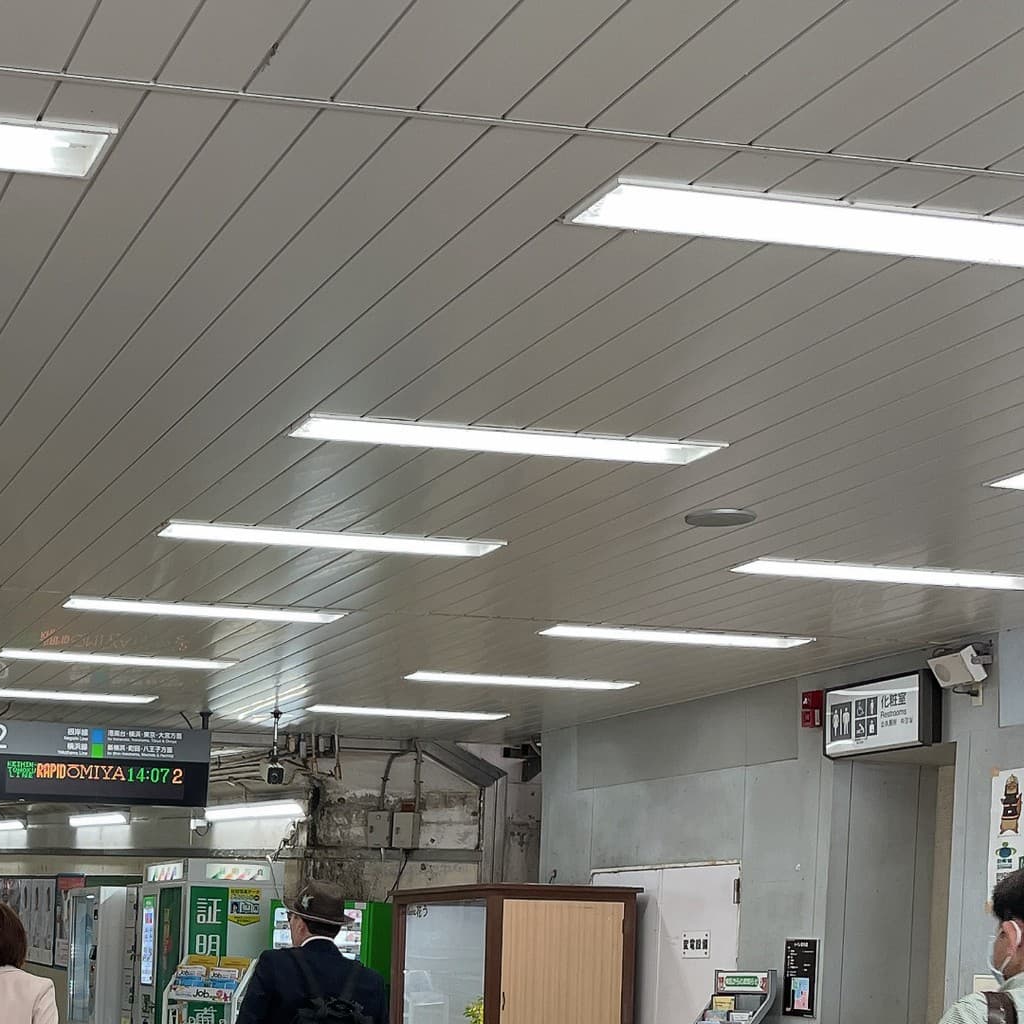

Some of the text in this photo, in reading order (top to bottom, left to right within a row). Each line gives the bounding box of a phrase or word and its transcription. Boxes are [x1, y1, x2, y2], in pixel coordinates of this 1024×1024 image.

[36, 763, 66, 779] RAPID
[127, 767, 170, 783] 14:07
[171, 768, 183, 784] 2
